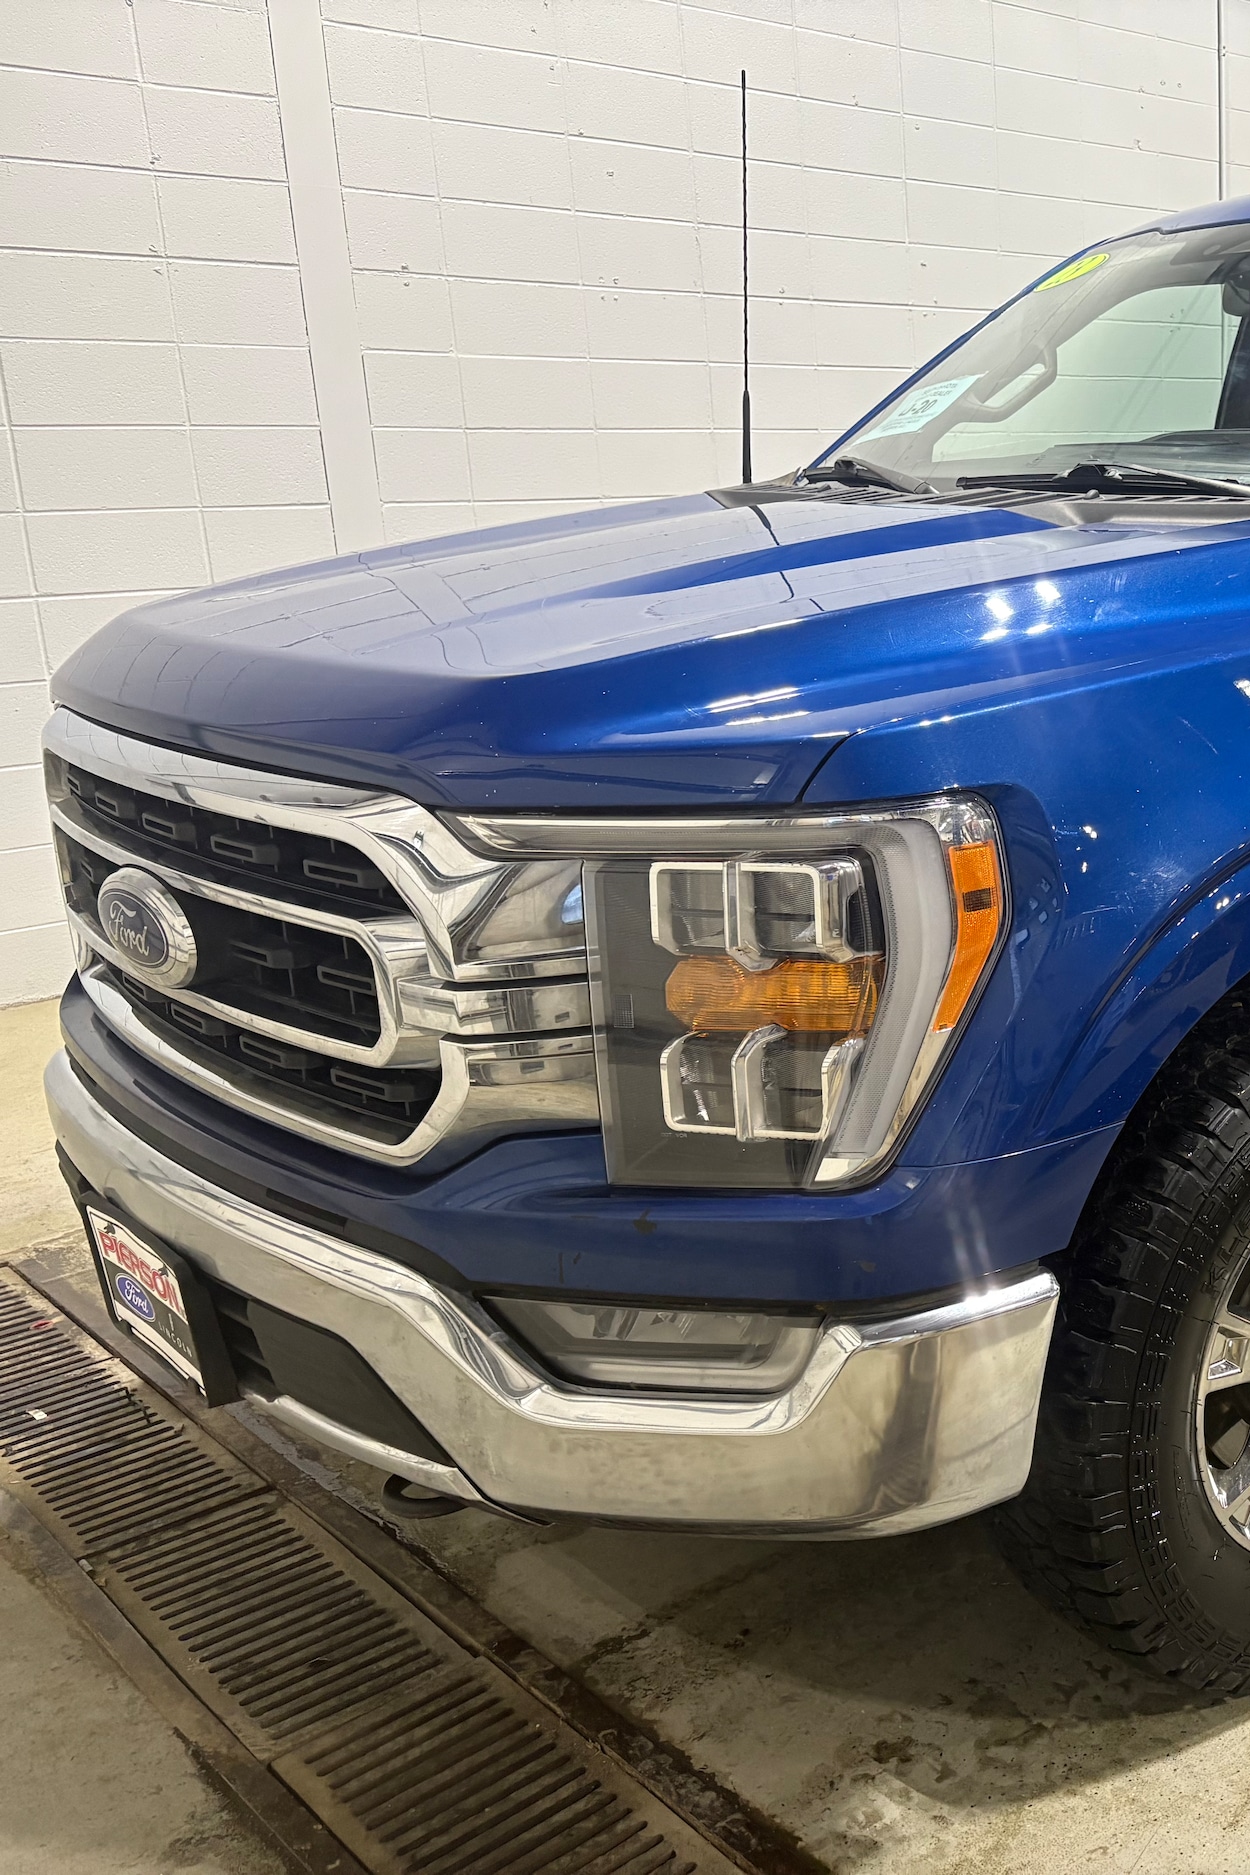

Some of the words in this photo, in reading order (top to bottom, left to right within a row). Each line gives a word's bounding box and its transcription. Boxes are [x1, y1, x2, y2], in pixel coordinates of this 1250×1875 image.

[109, 900, 150, 957] Ford
[97, 1228, 183, 1314] PIERSON
[123, 1279, 150, 1315] Ford
[157, 1320, 193, 1358] LINCOLN
